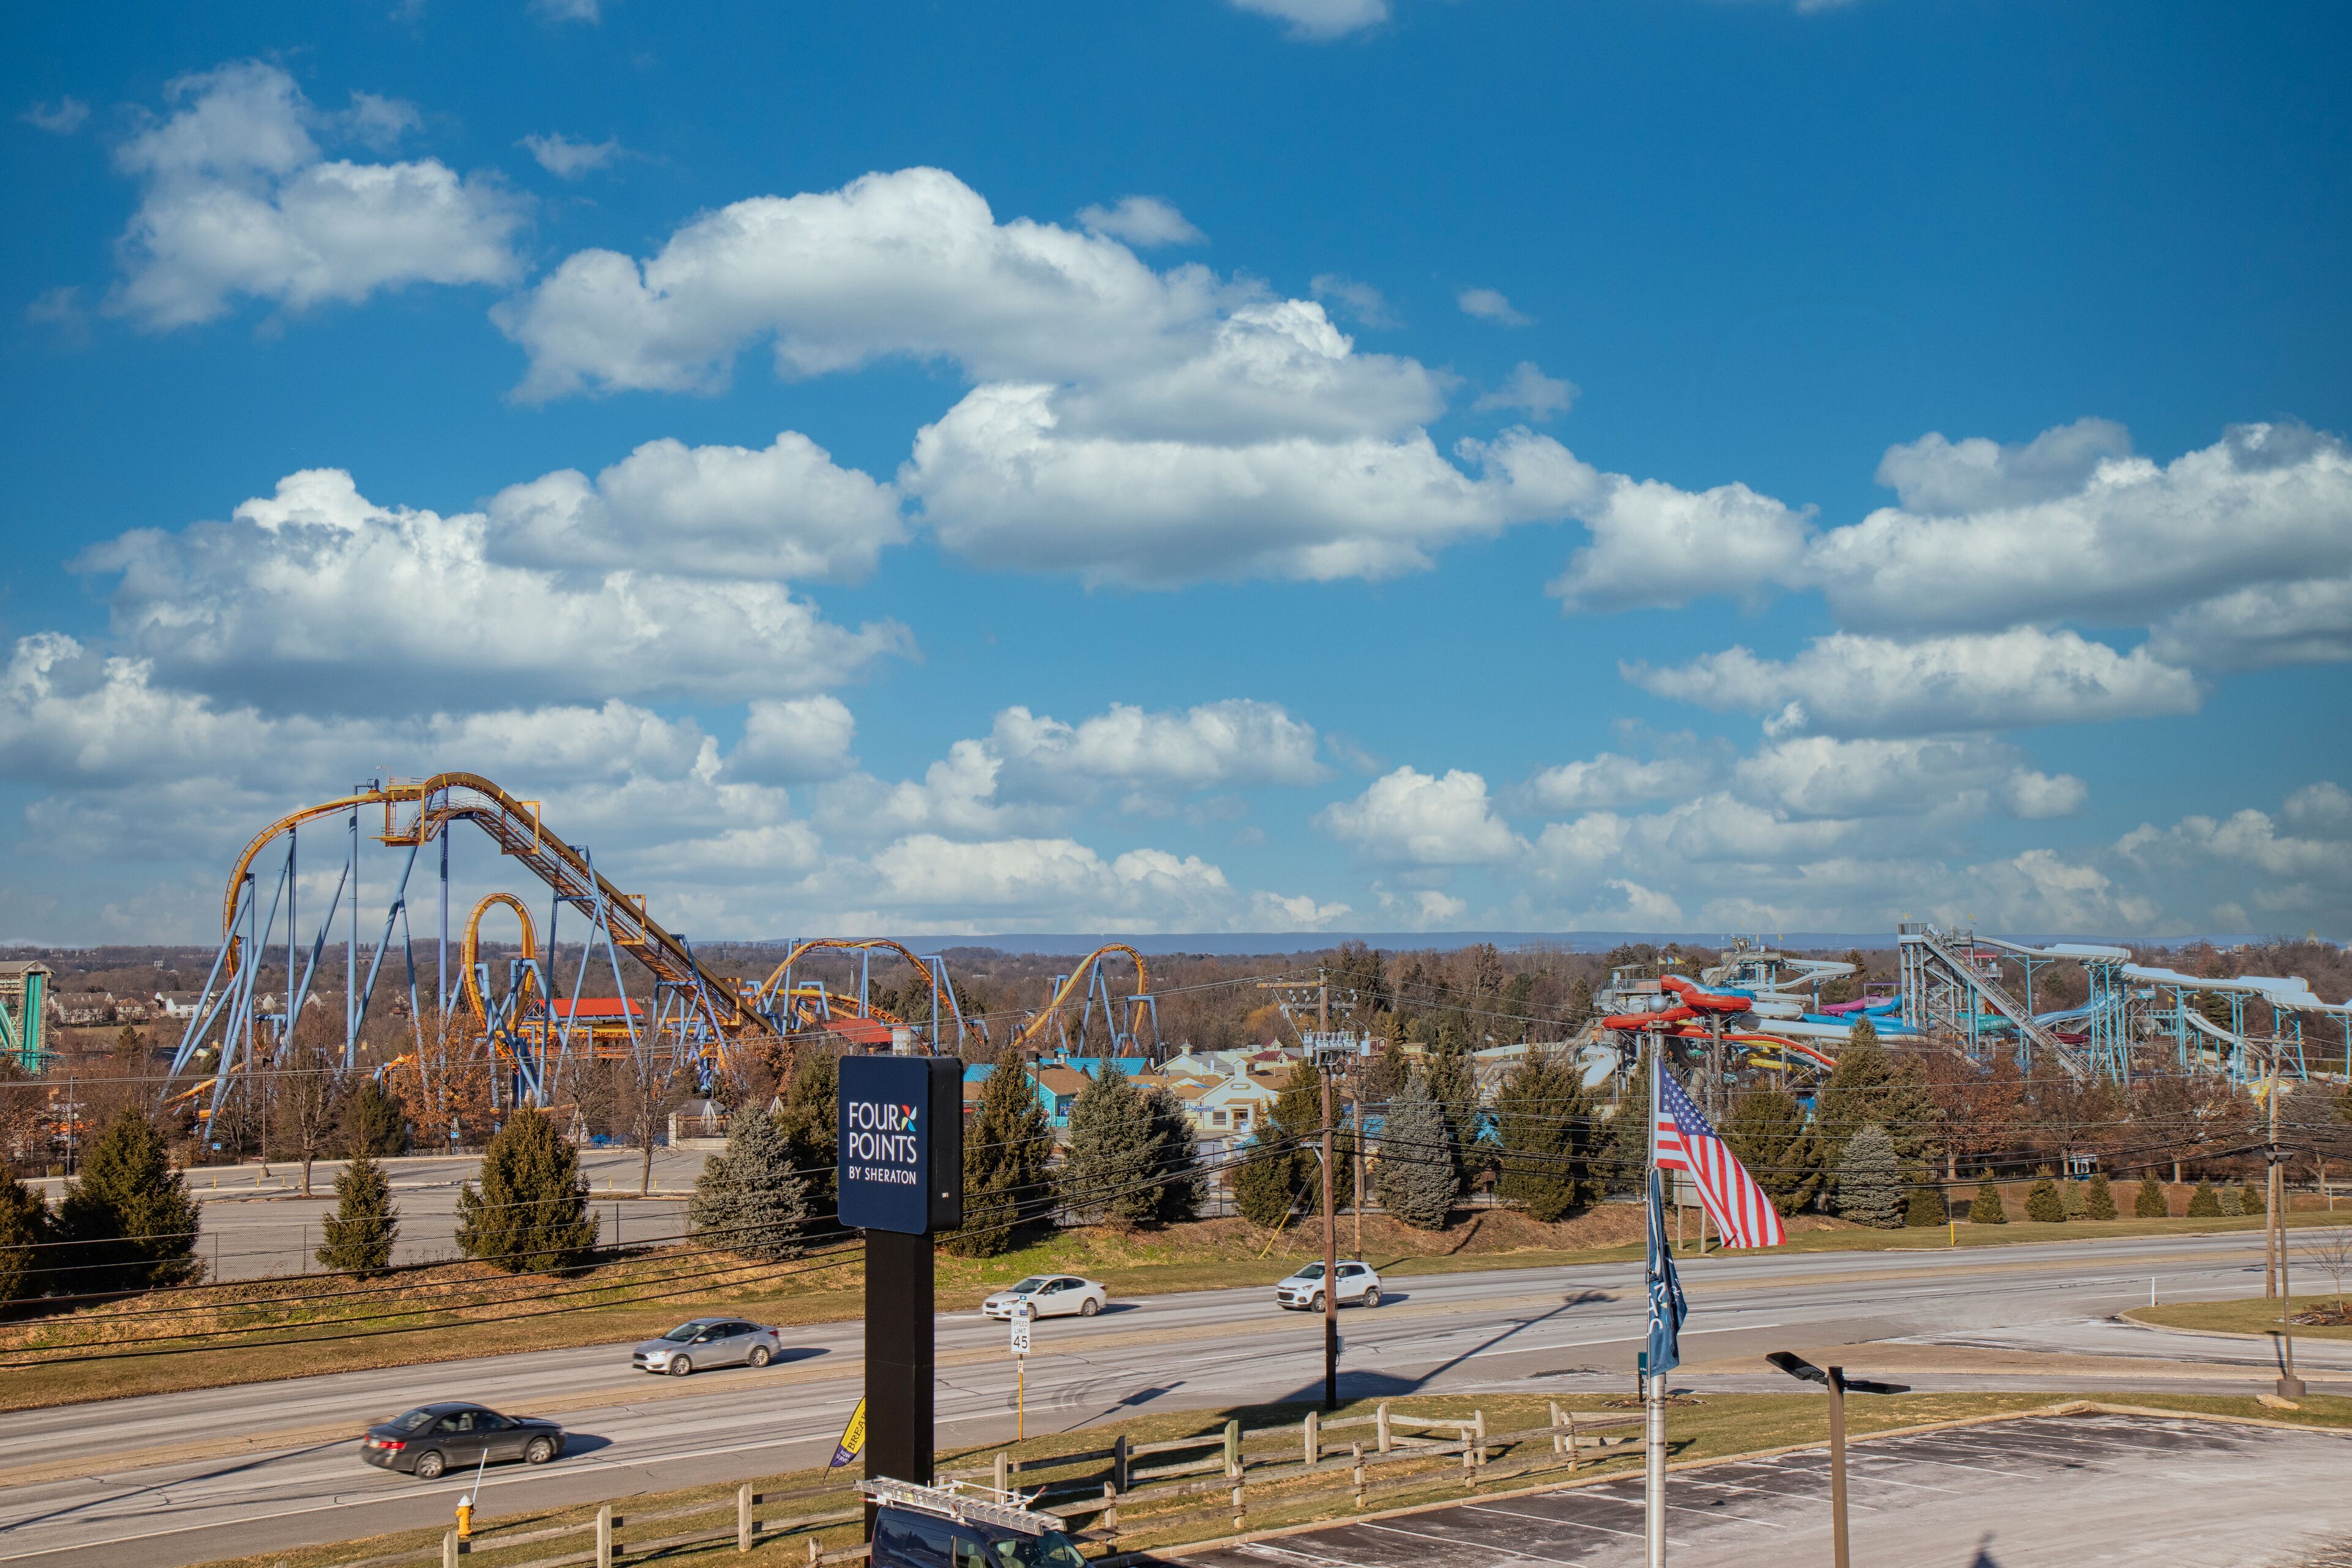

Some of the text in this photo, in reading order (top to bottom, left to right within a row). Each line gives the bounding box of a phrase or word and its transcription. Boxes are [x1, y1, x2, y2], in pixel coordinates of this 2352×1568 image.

[849, 1102, 900, 1131] FOUR
[849, 1132, 916, 1163] POINTS
[849, 1166, 916, 1185] BY SHERATON
[1013, 1335, 1028, 1348] 45
